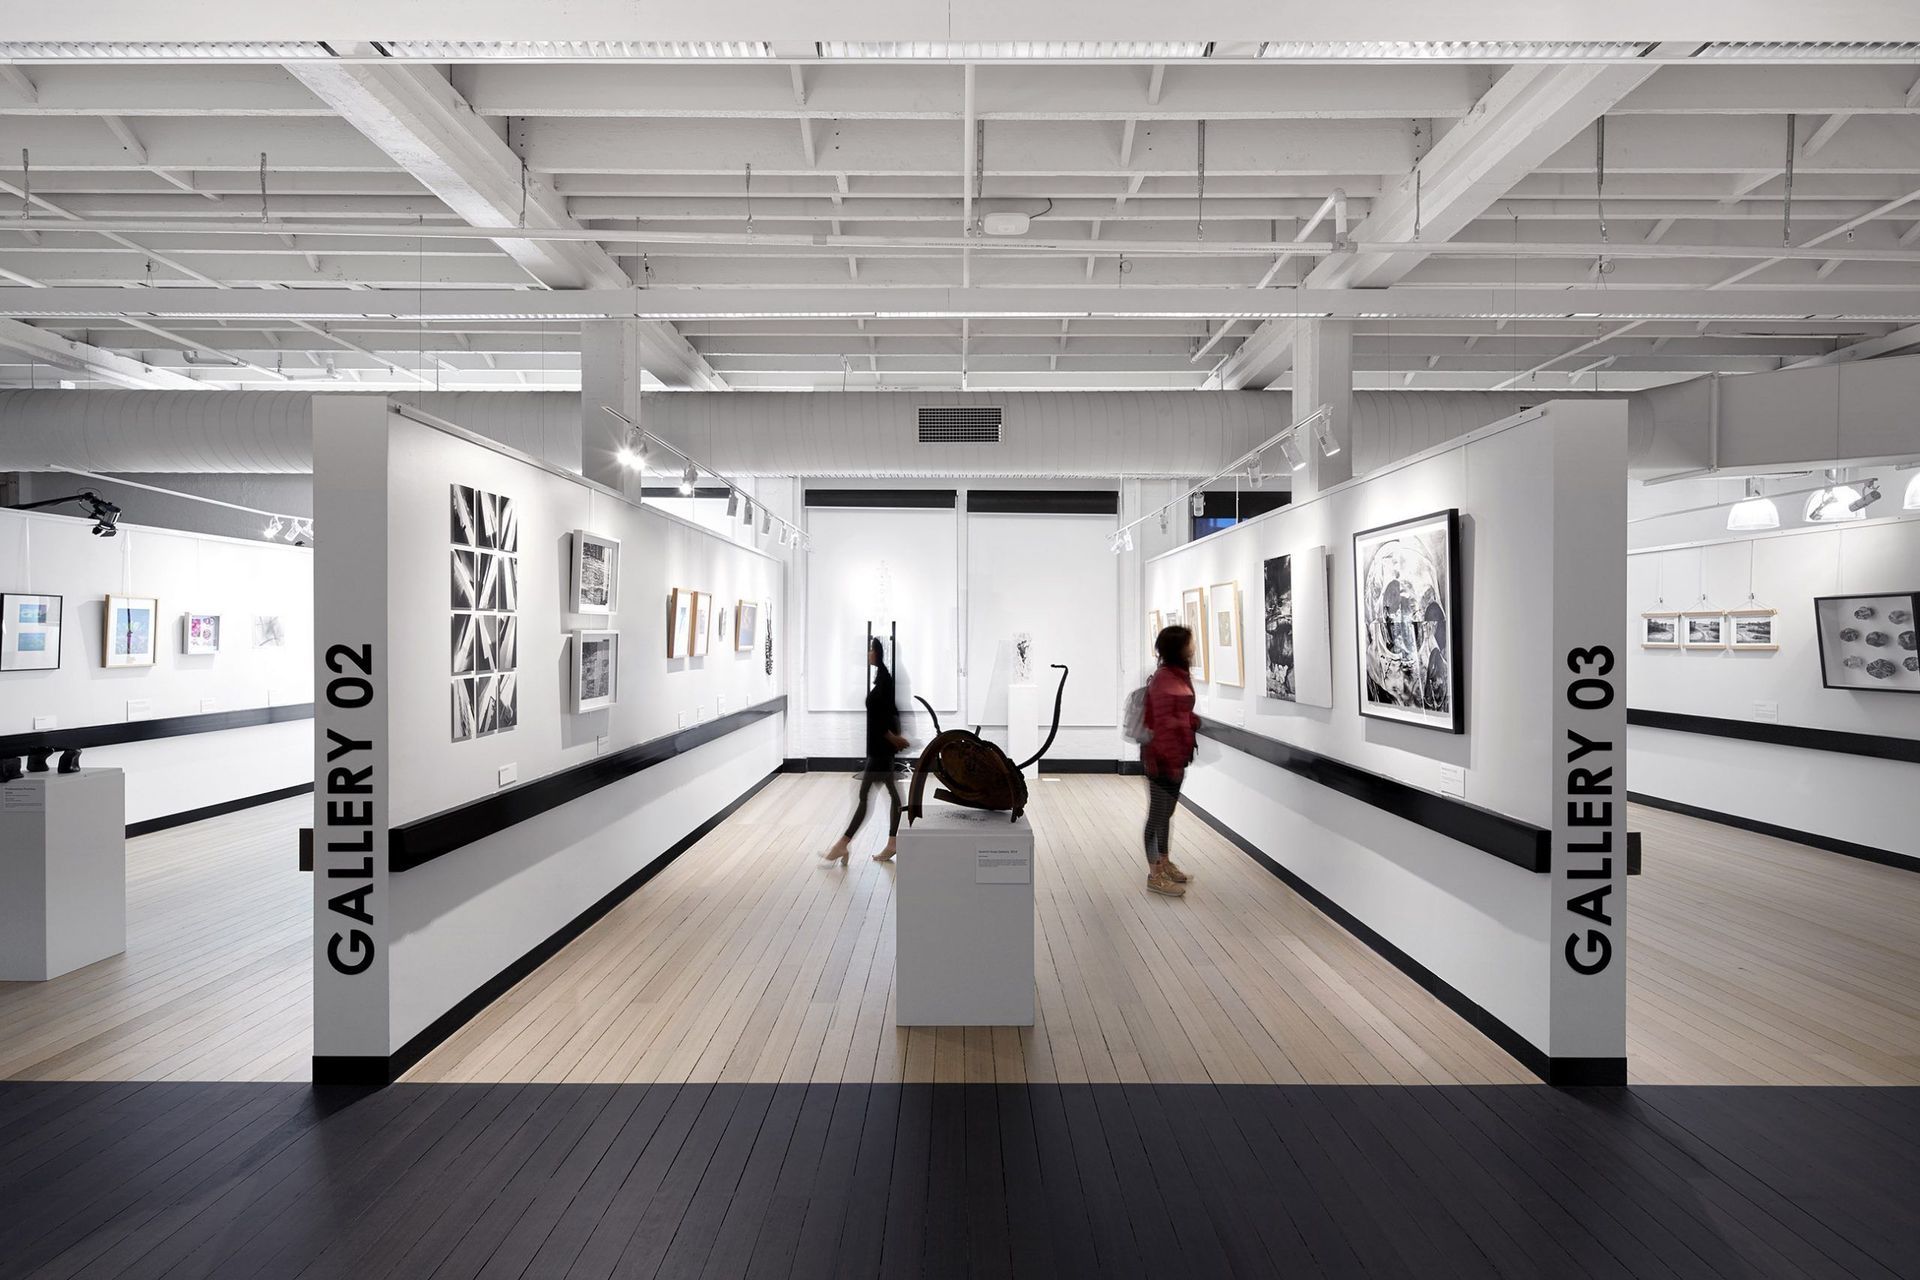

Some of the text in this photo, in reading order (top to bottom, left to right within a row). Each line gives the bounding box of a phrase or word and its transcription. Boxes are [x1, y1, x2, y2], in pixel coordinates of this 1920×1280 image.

[325, 644, 375, 975] GALLERY 02
[1565, 645, 1614, 975] GALLERY 03
